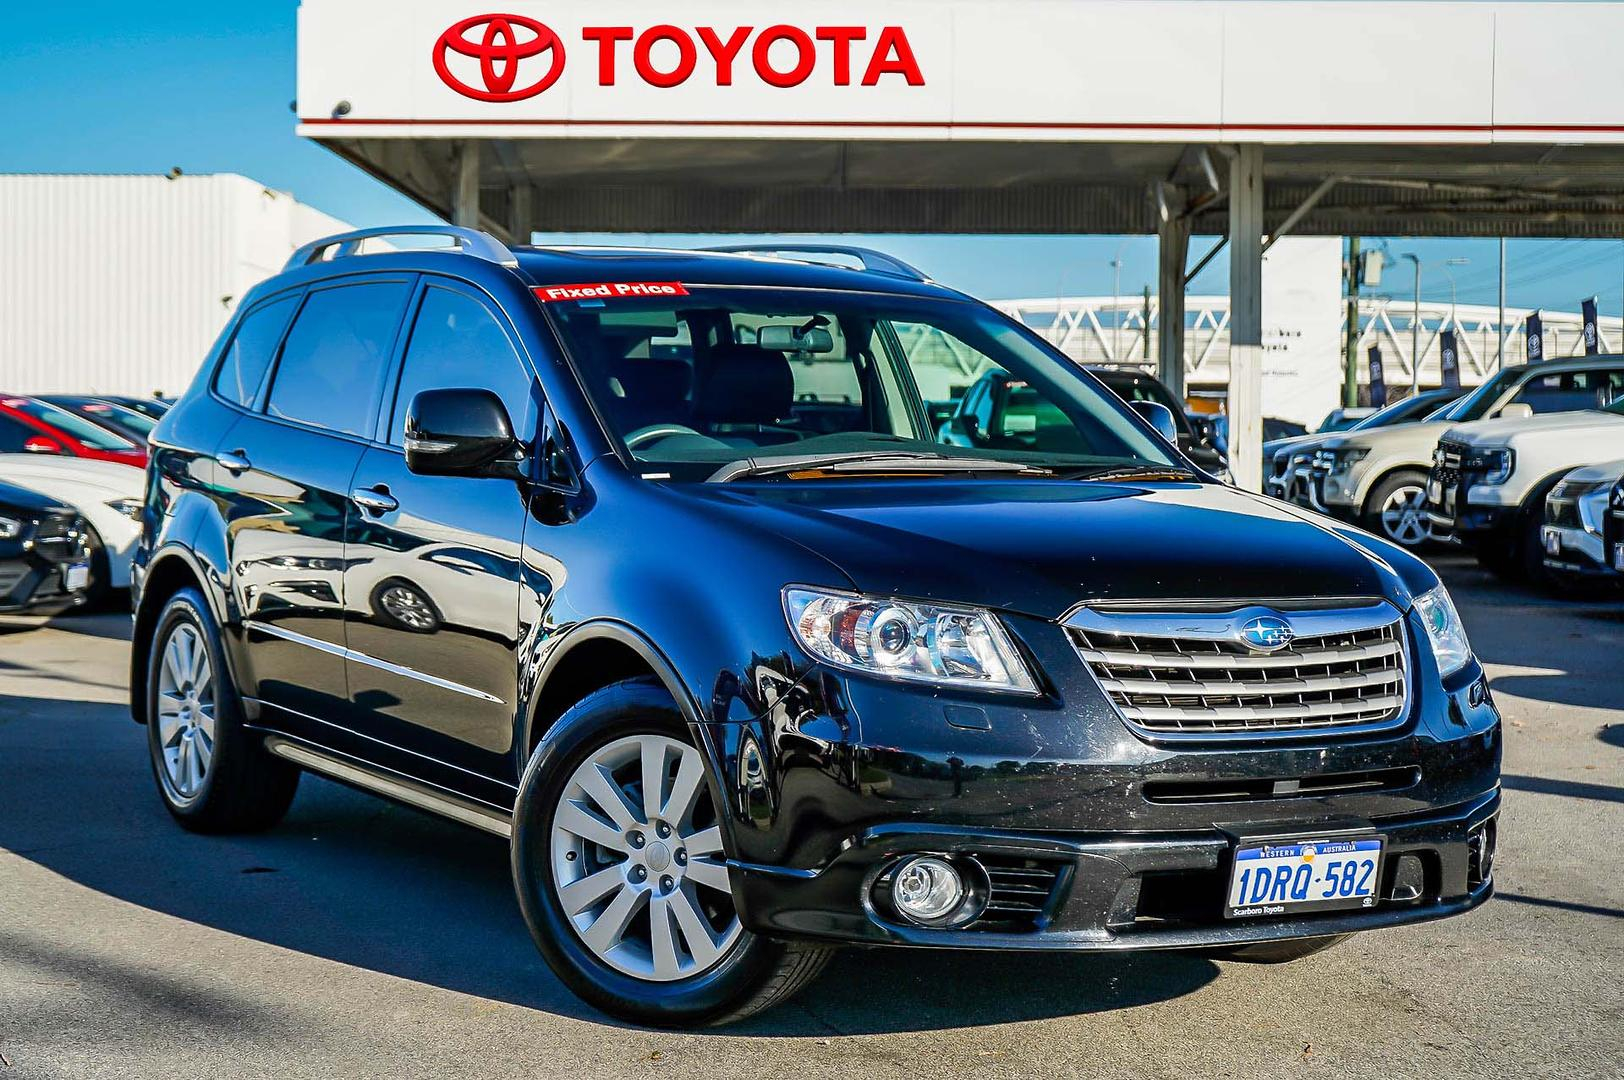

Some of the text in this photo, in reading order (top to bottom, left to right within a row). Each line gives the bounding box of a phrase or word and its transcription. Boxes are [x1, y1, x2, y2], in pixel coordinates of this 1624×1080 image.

[582, 25, 925, 88] TOYOTA
[546, 283, 676, 299] Fixed Price
[1322, 845, 1357, 854] AUSTRALIA
[1233, 905, 1285, 916] Scarboro Toyota
